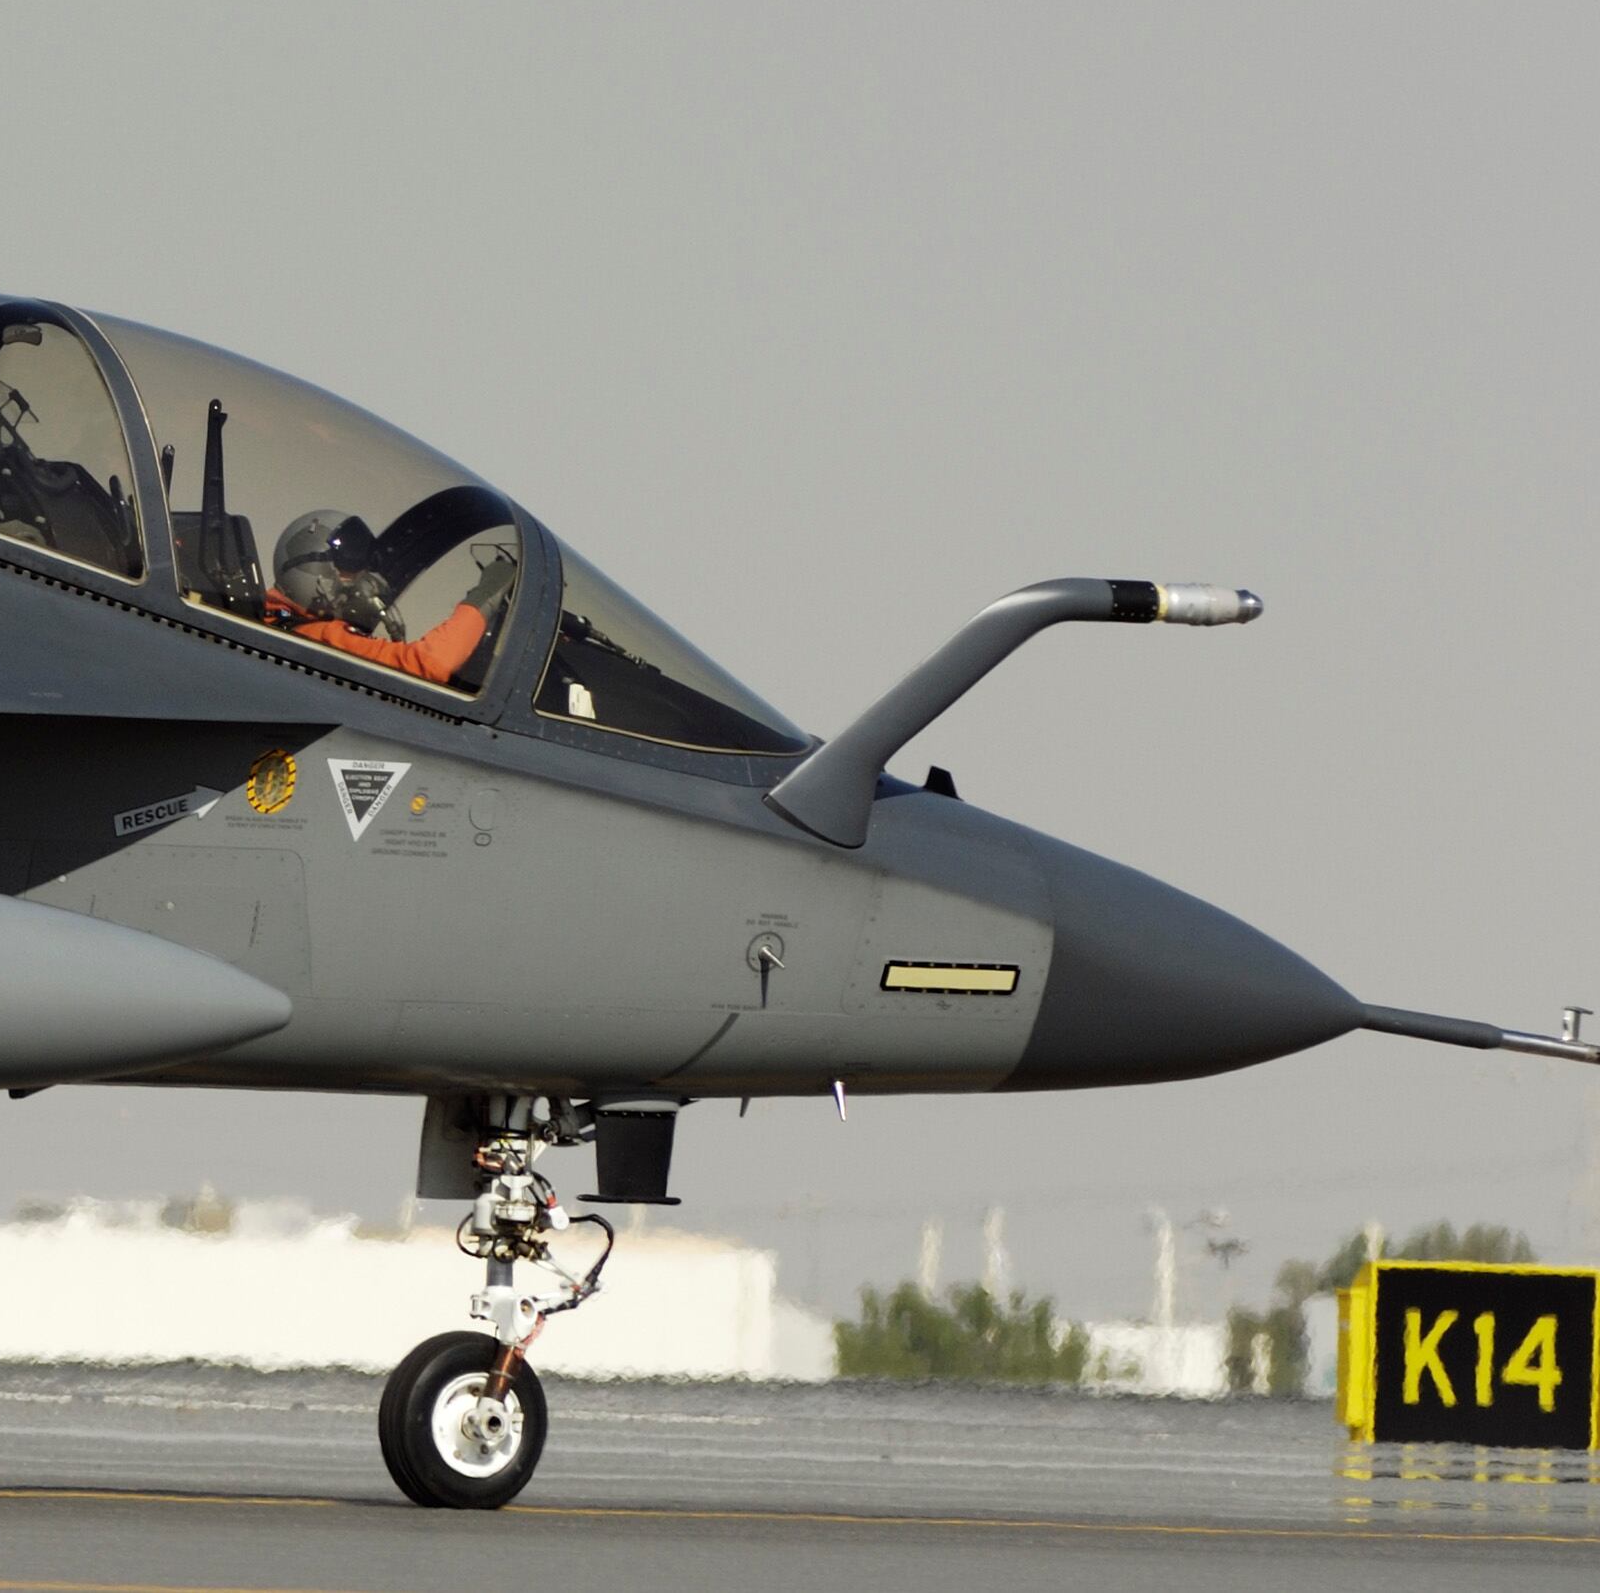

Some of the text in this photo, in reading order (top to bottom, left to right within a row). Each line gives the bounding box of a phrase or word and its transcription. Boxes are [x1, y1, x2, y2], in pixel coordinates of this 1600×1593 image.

[352, 761, 386, 769] DANGER
[122, 798, 189, 830] RESCUE
[337, 781, 353, 815] DANGER
[367, 784, 393, 816] DANGER
[1402, 1307, 1563, 1413] K14
